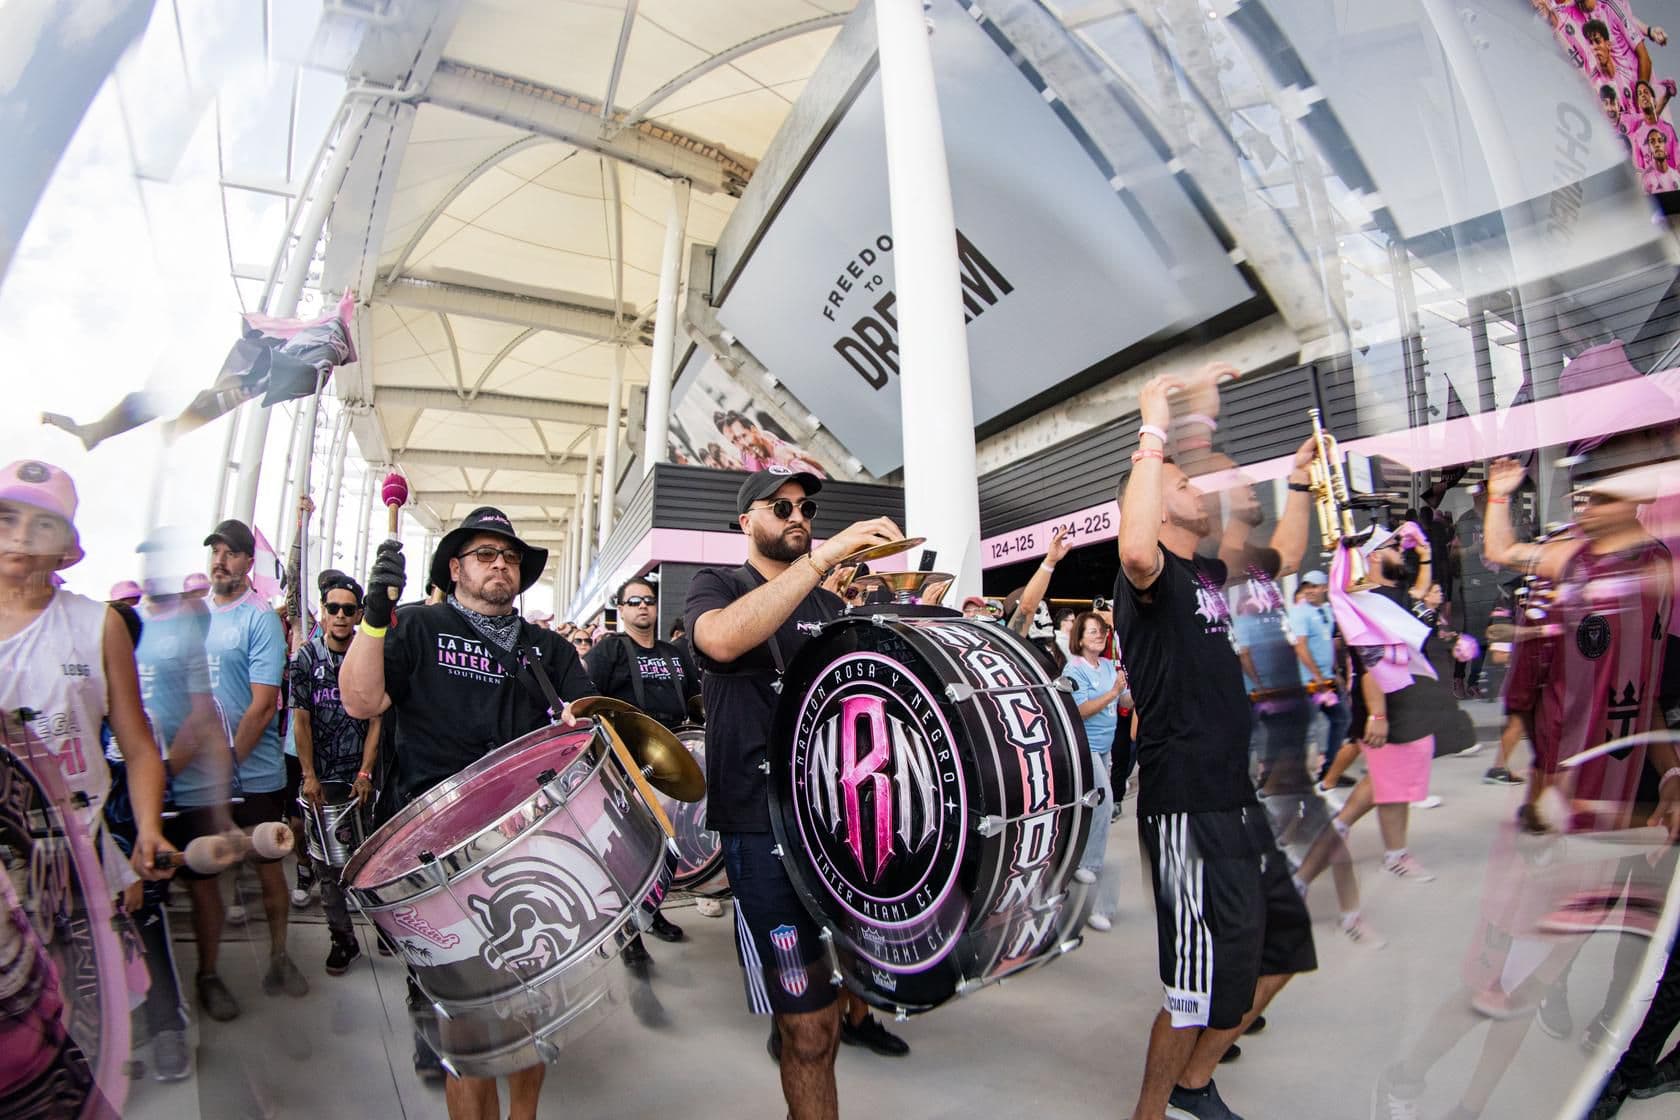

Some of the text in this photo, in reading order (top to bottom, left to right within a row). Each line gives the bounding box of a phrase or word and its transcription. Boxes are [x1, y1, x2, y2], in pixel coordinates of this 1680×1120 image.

[823, 234, 894, 322] FREEDO
[864, 274, 884, 293] TO
[833, 227, 1015, 391] DRM
[991, 533, 1035, 559] 124-125
[437, 637, 494, 659] LA BAN
[438, 649, 491, 673] INTER
[447, 668, 501, 685] SOUTHERN
[313, 687, 341, 705] NAC
[834, 662, 876, 685] ROSA
[891, 673, 900, 688] Y
[910, 693, 956, 783] NEGRO
[816, 853, 934, 921] INTER MIAMI CF
